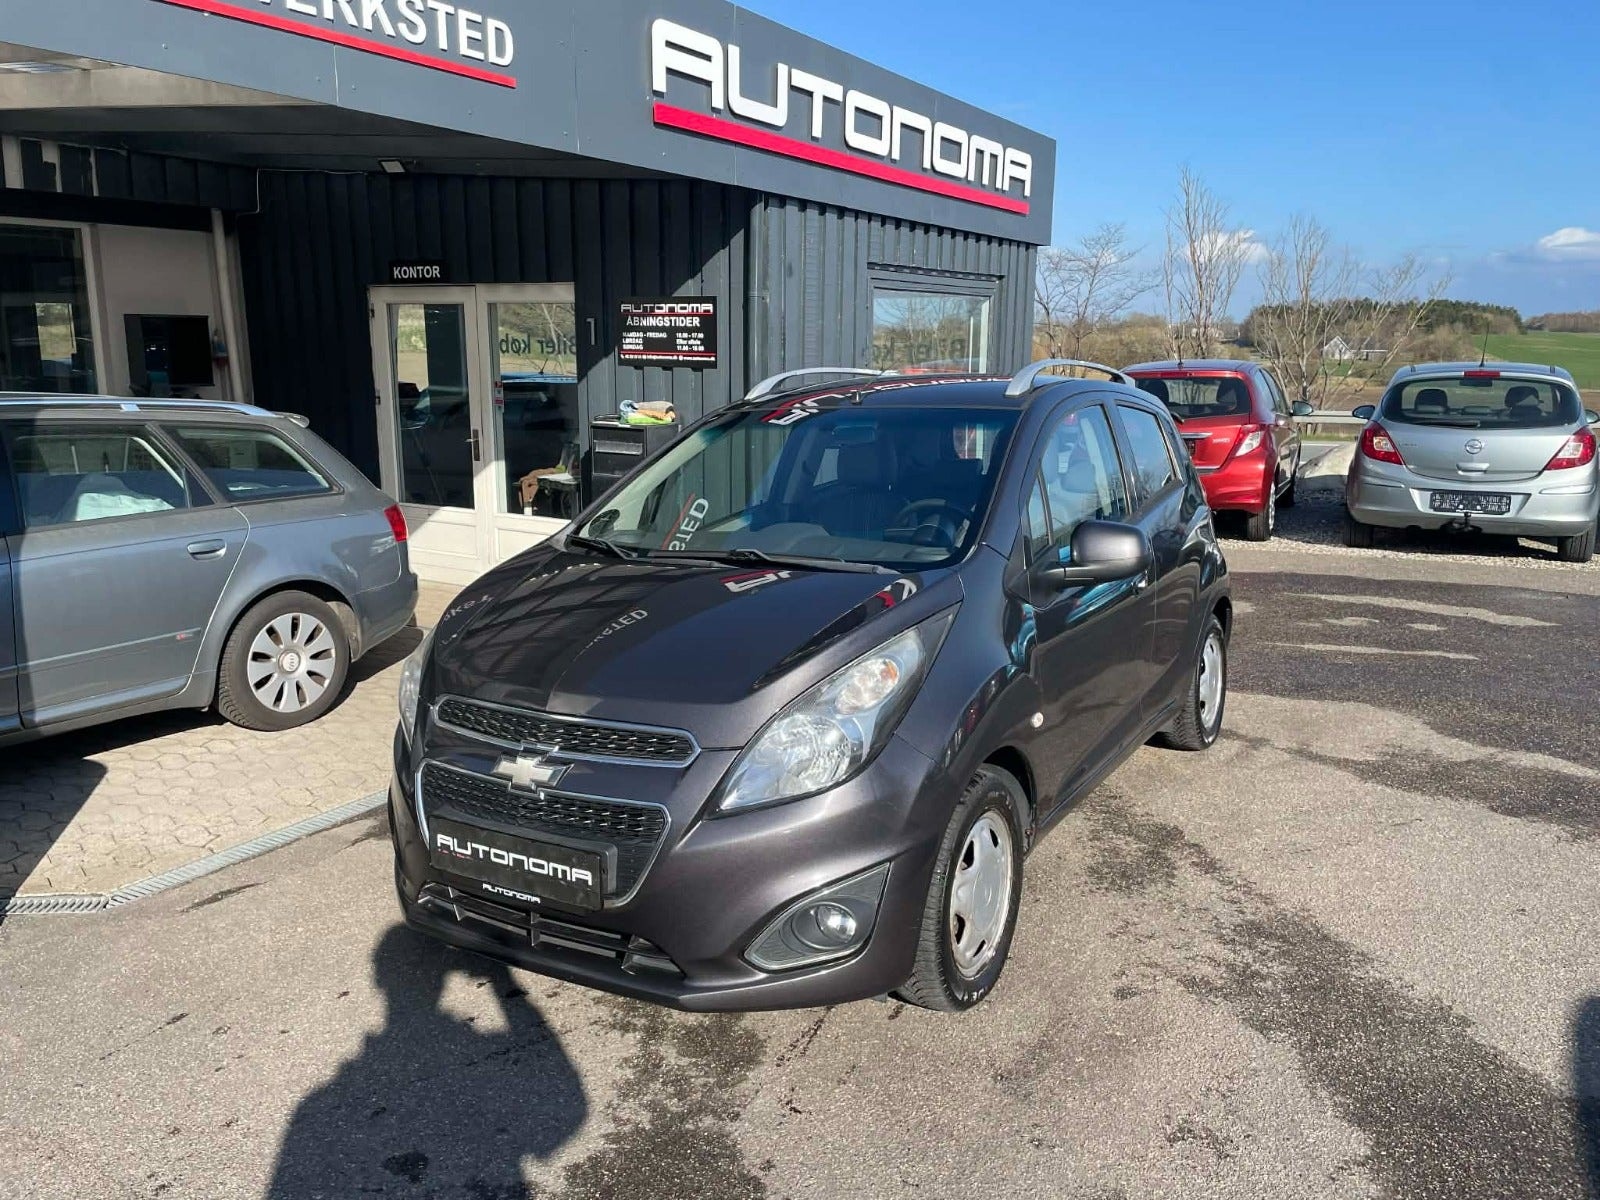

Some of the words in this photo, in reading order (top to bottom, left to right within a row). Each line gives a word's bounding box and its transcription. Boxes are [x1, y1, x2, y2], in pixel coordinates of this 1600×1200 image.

[652, 18, 1032, 197] AUTONOMA
[393, 265, 440, 279] KONTOR
[621, 303, 713, 313] AUTONOMA
[437, 834, 592, 886] AUTONOMA
[483, 883, 541, 904] AUTONOMA
